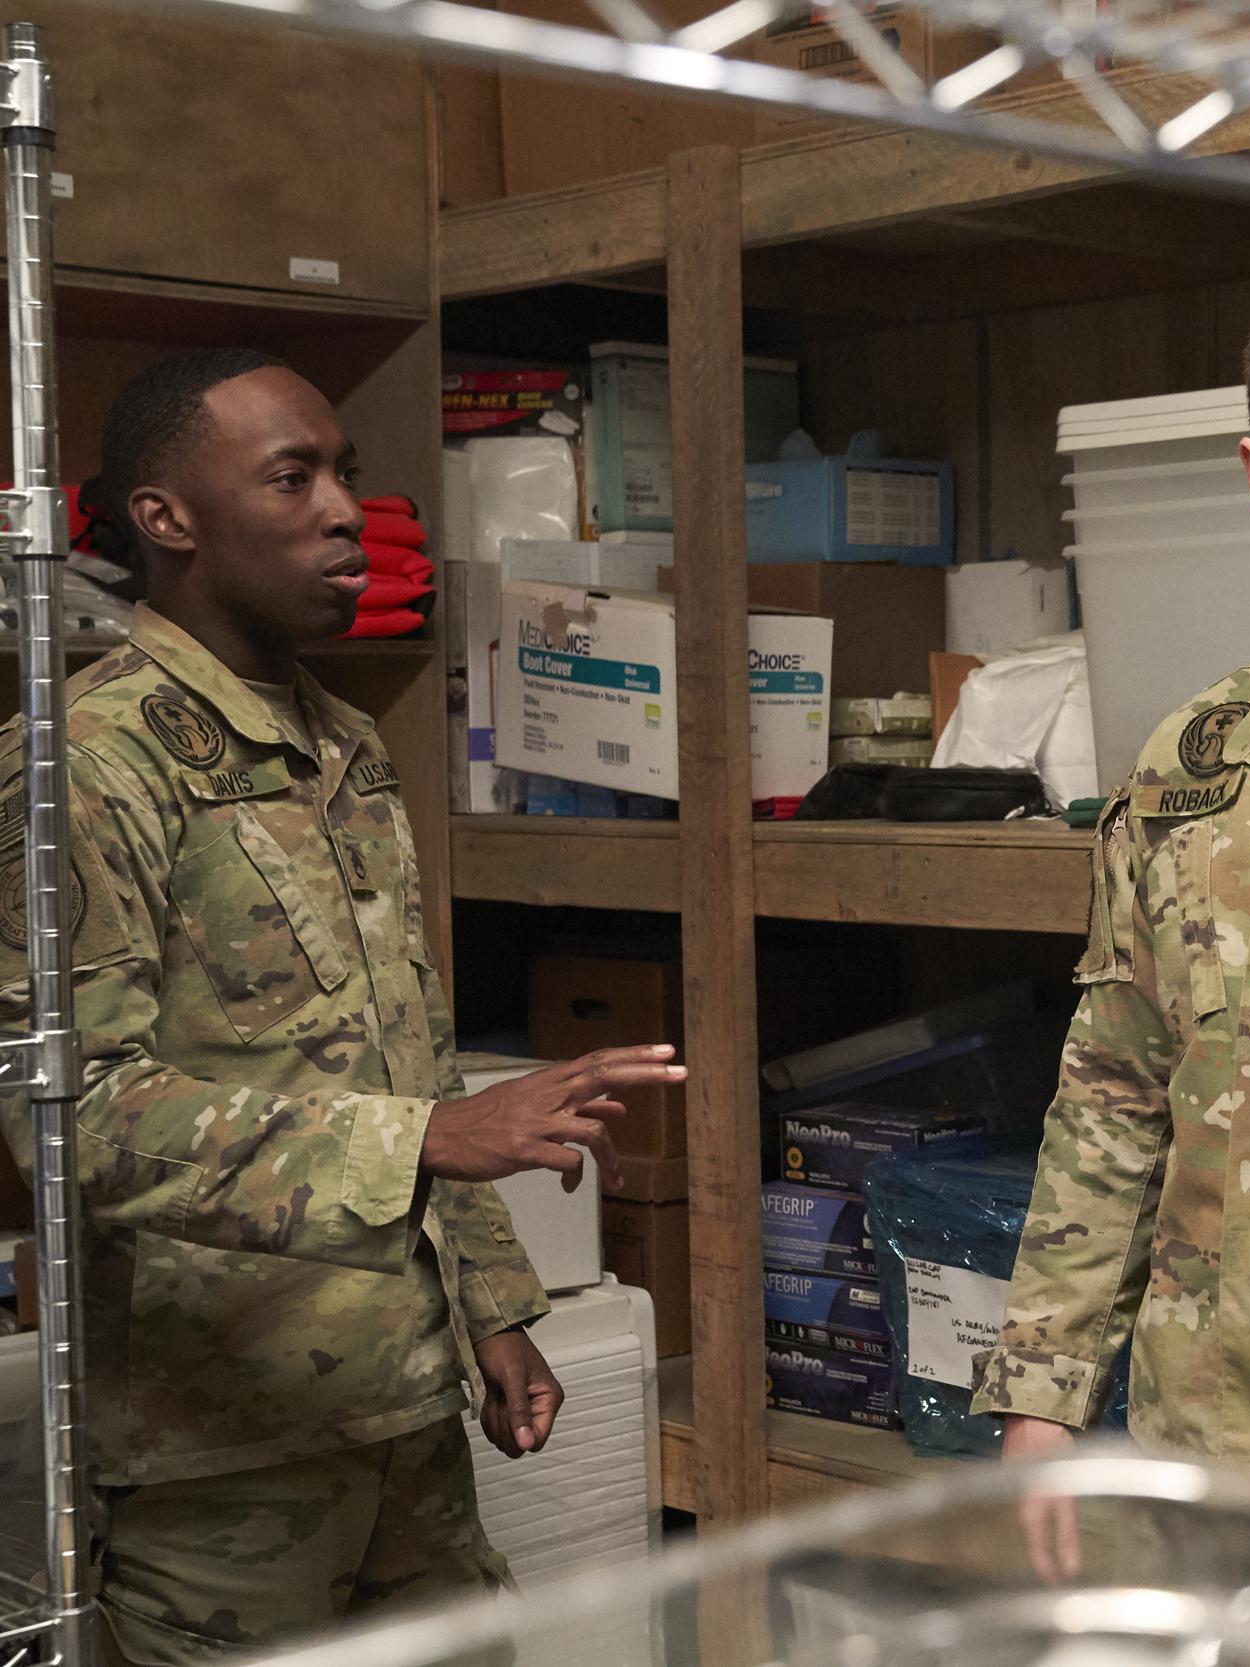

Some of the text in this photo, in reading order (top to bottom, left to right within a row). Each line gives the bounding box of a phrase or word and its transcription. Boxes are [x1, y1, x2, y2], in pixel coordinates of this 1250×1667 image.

[523, 651, 573, 678] Boot Cover
[208, 771, 254, 797] DAVIS
[1159, 779, 1229, 813] ROBACK
[785, 1120, 850, 1149] NeoPro
[951, 1318, 962, 1327] US
[912, 1364, 936, 1375] 2 of 2
